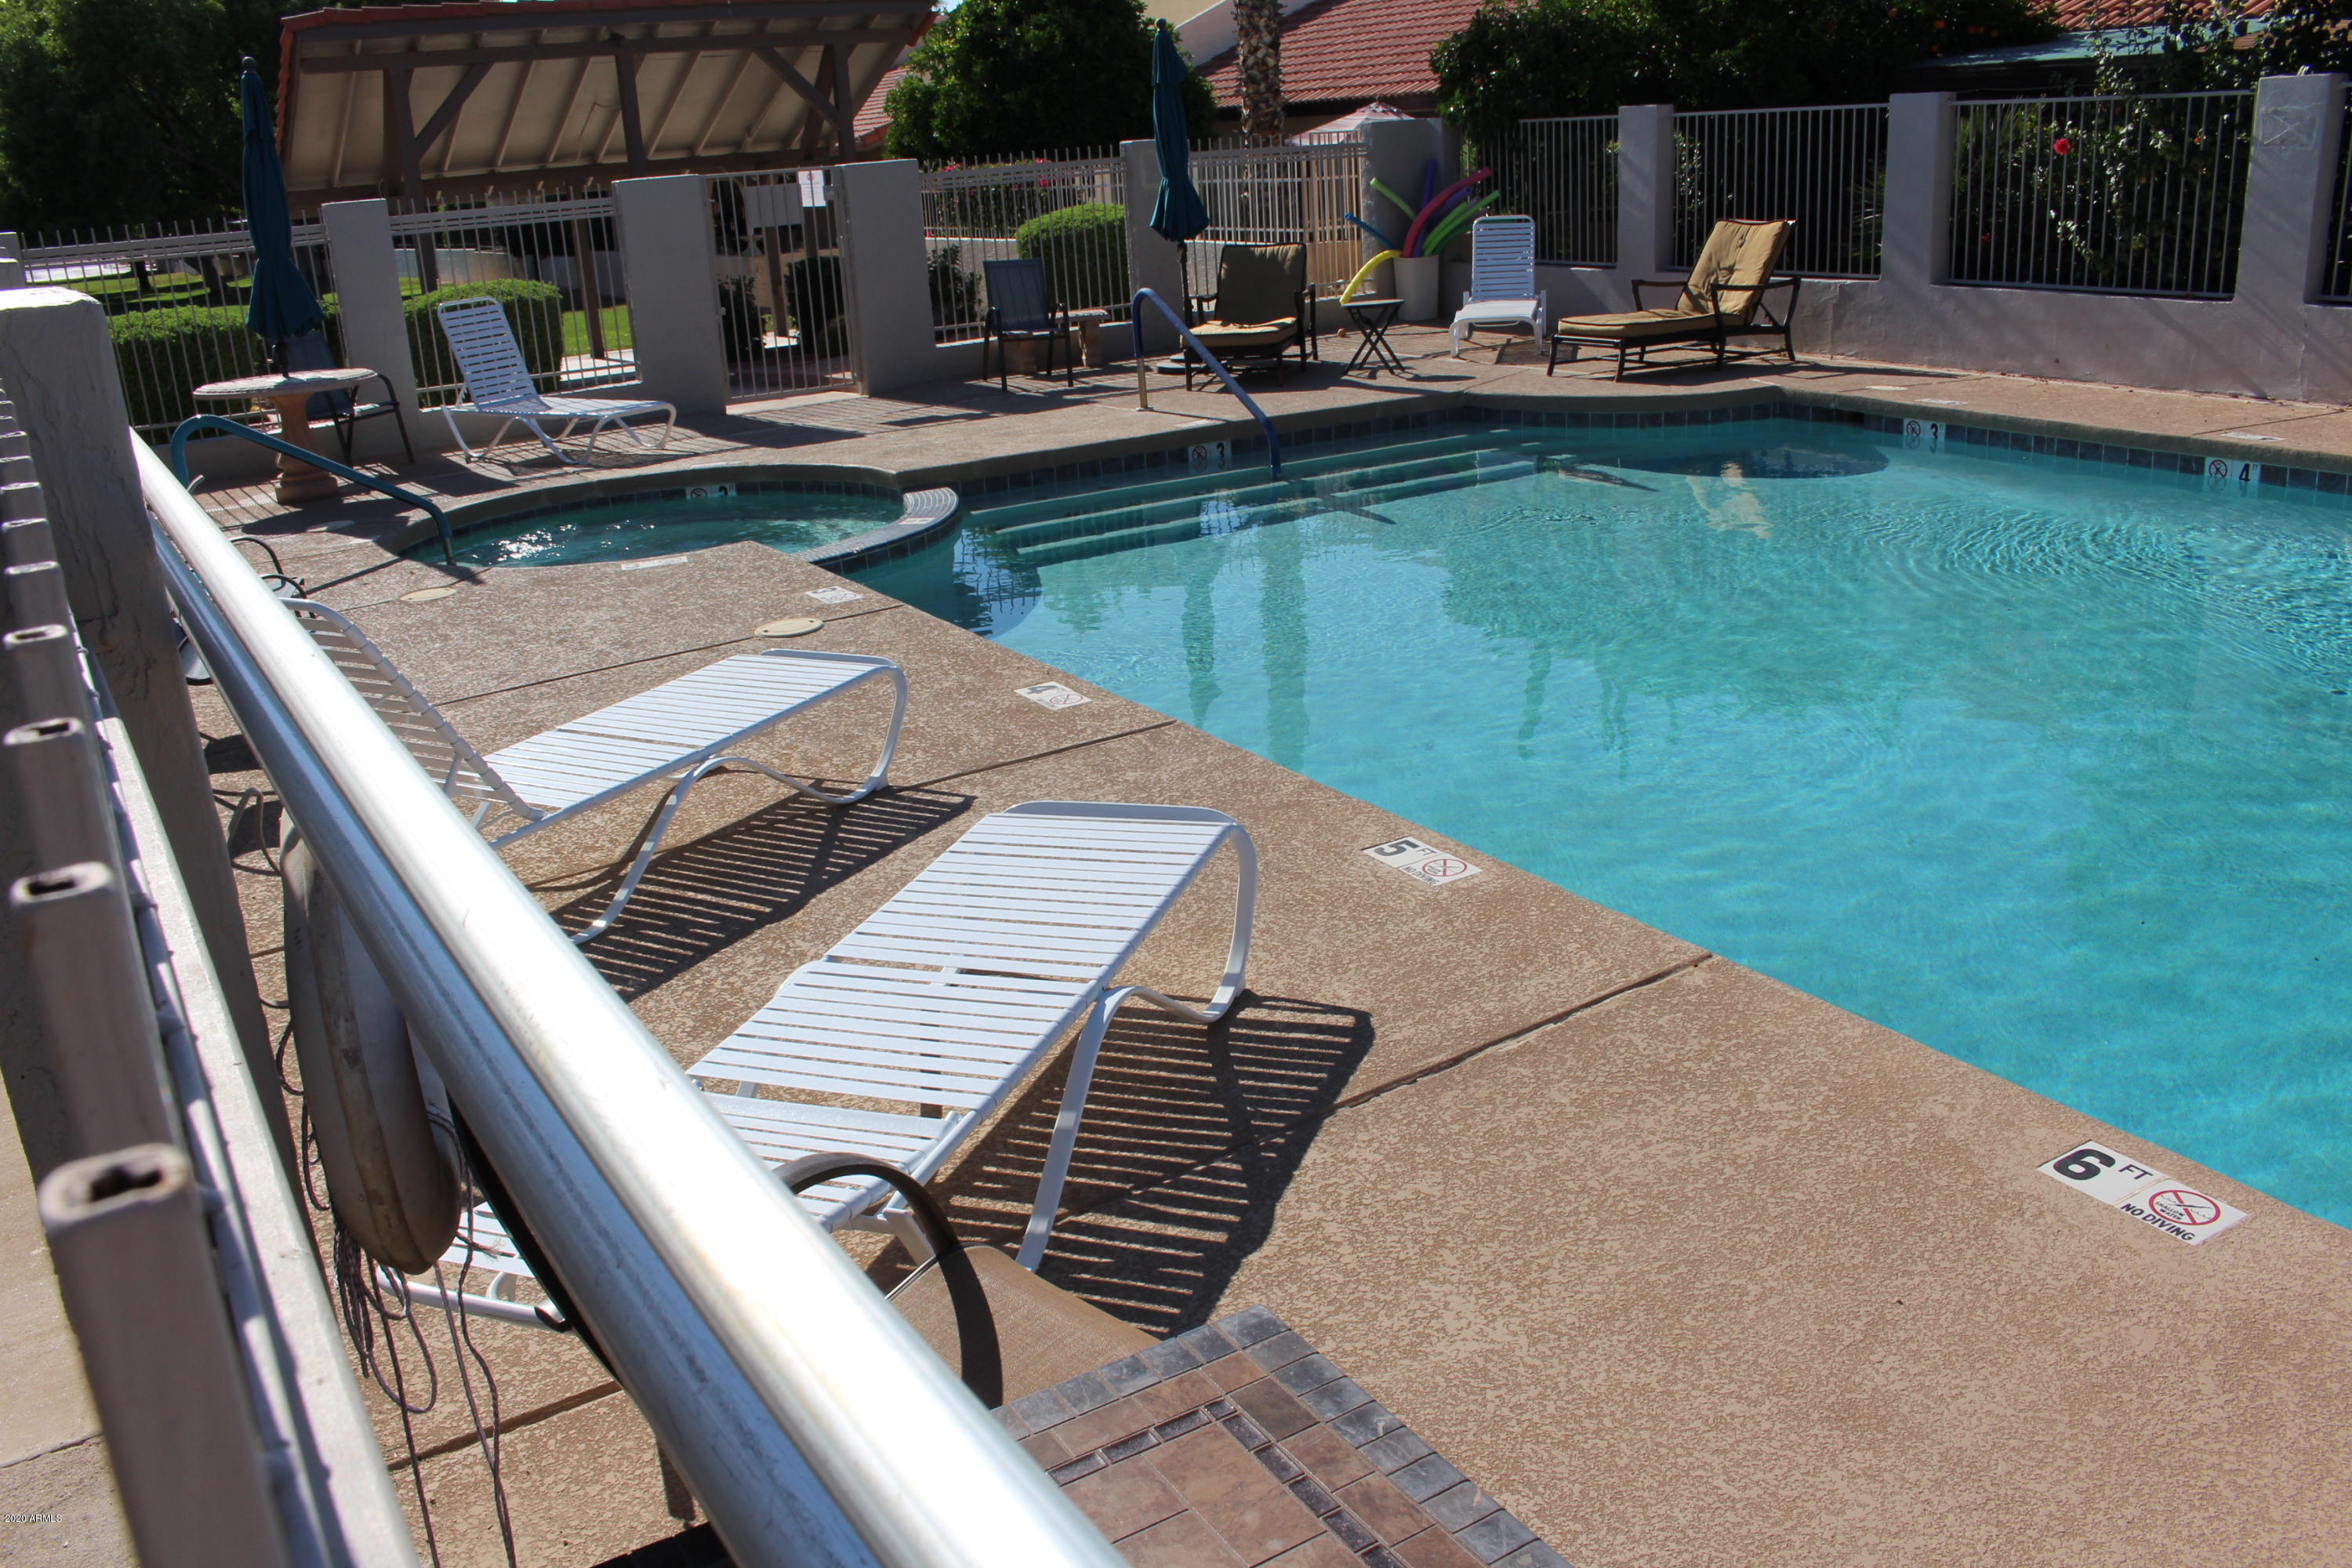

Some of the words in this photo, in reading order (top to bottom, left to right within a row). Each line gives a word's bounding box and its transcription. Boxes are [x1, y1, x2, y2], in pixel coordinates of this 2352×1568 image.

[2239, 463, 2250, 481] 4
[1026, 684, 1058, 695] 4
[1374, 840, 1421, 856] 5
[1414, 848, 1438, 856] FT
[1412, 870, 1440, 885] DIVING
[2053, 1149, 2116, 1181] 6
[2118, 1163, 2154, 1180] FT
[2155, 1201, 2185, 1217] SHALLOW
[2159, 1208, 2183, 1221] WATER
[2120, 1203, 2143, 1217] NO
[2142, 1214, 2196, 1241] DIVING
